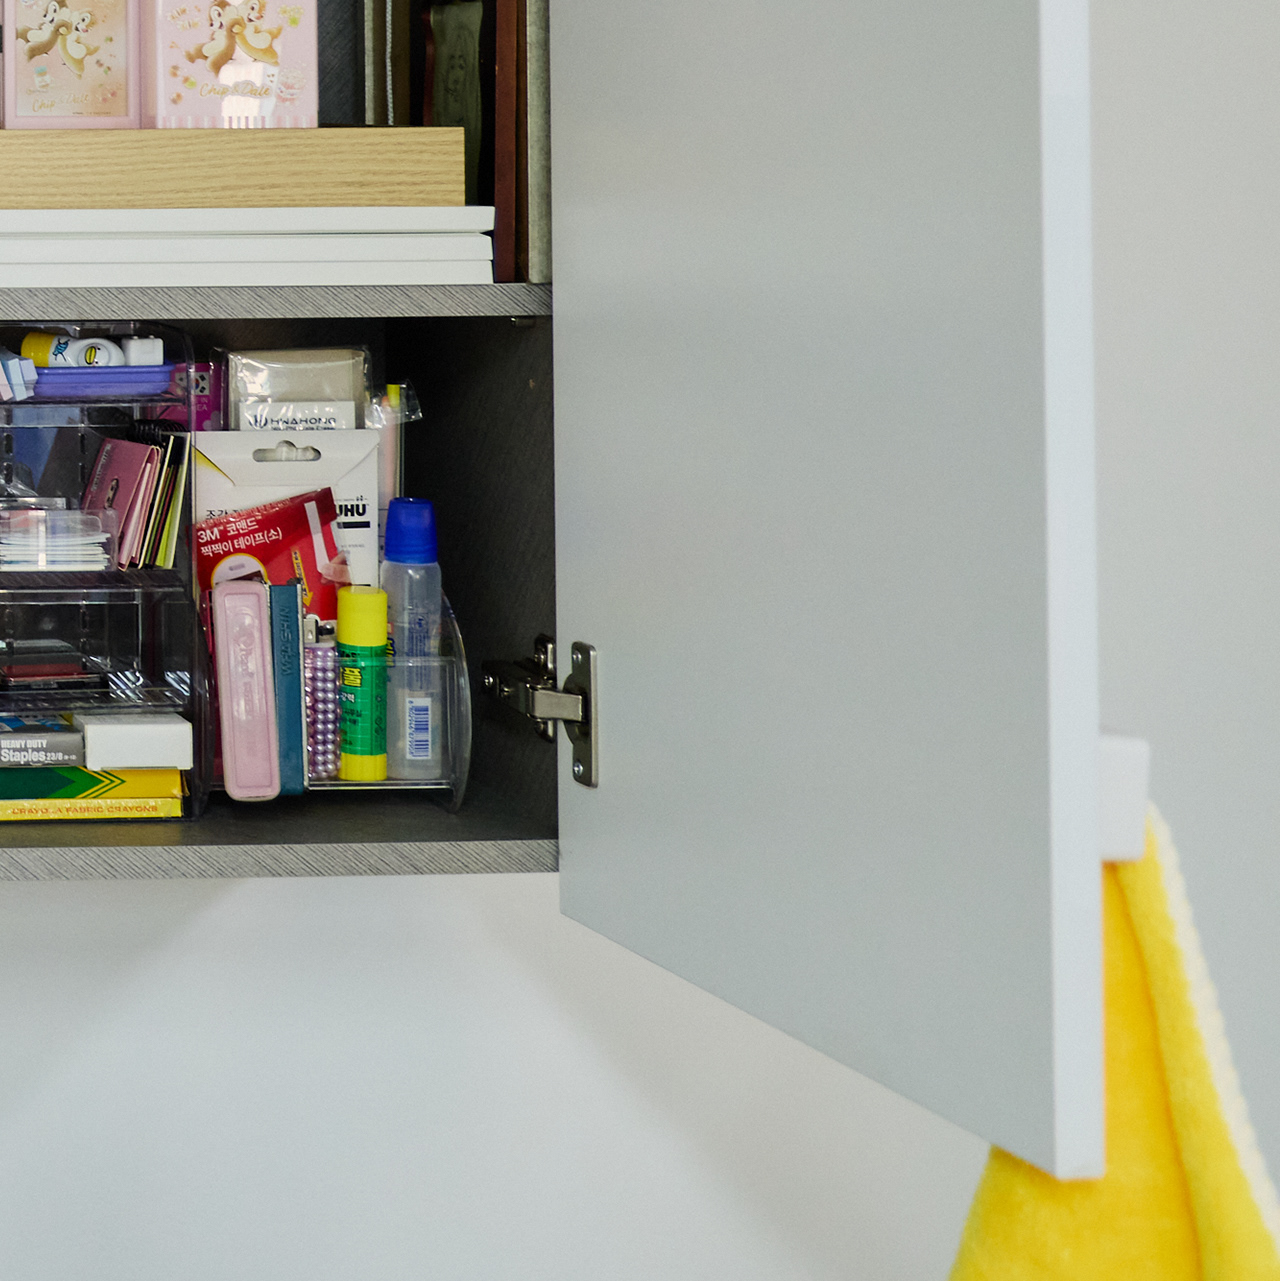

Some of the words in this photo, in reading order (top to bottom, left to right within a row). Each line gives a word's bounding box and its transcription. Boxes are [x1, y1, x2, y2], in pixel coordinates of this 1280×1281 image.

[199, 83, 228, 99] Chip
[270, 417, 337, 426] HWAHONG
[226, 519, 259, 537] 코맨드
[200, 540, 234, 558] 찍찍이
[234, 527, 283, 550] 테이프(소)
[0, 739, 25, 749] HEAVY
[26, 739, 47, 748] DUTY
[0, 749, 46, 763] Staples
[46, 752, 64, 761] 23/8
[12, 806, 62, 816] CRAYOA
[107, 805, 159, 814] CRAYONS
